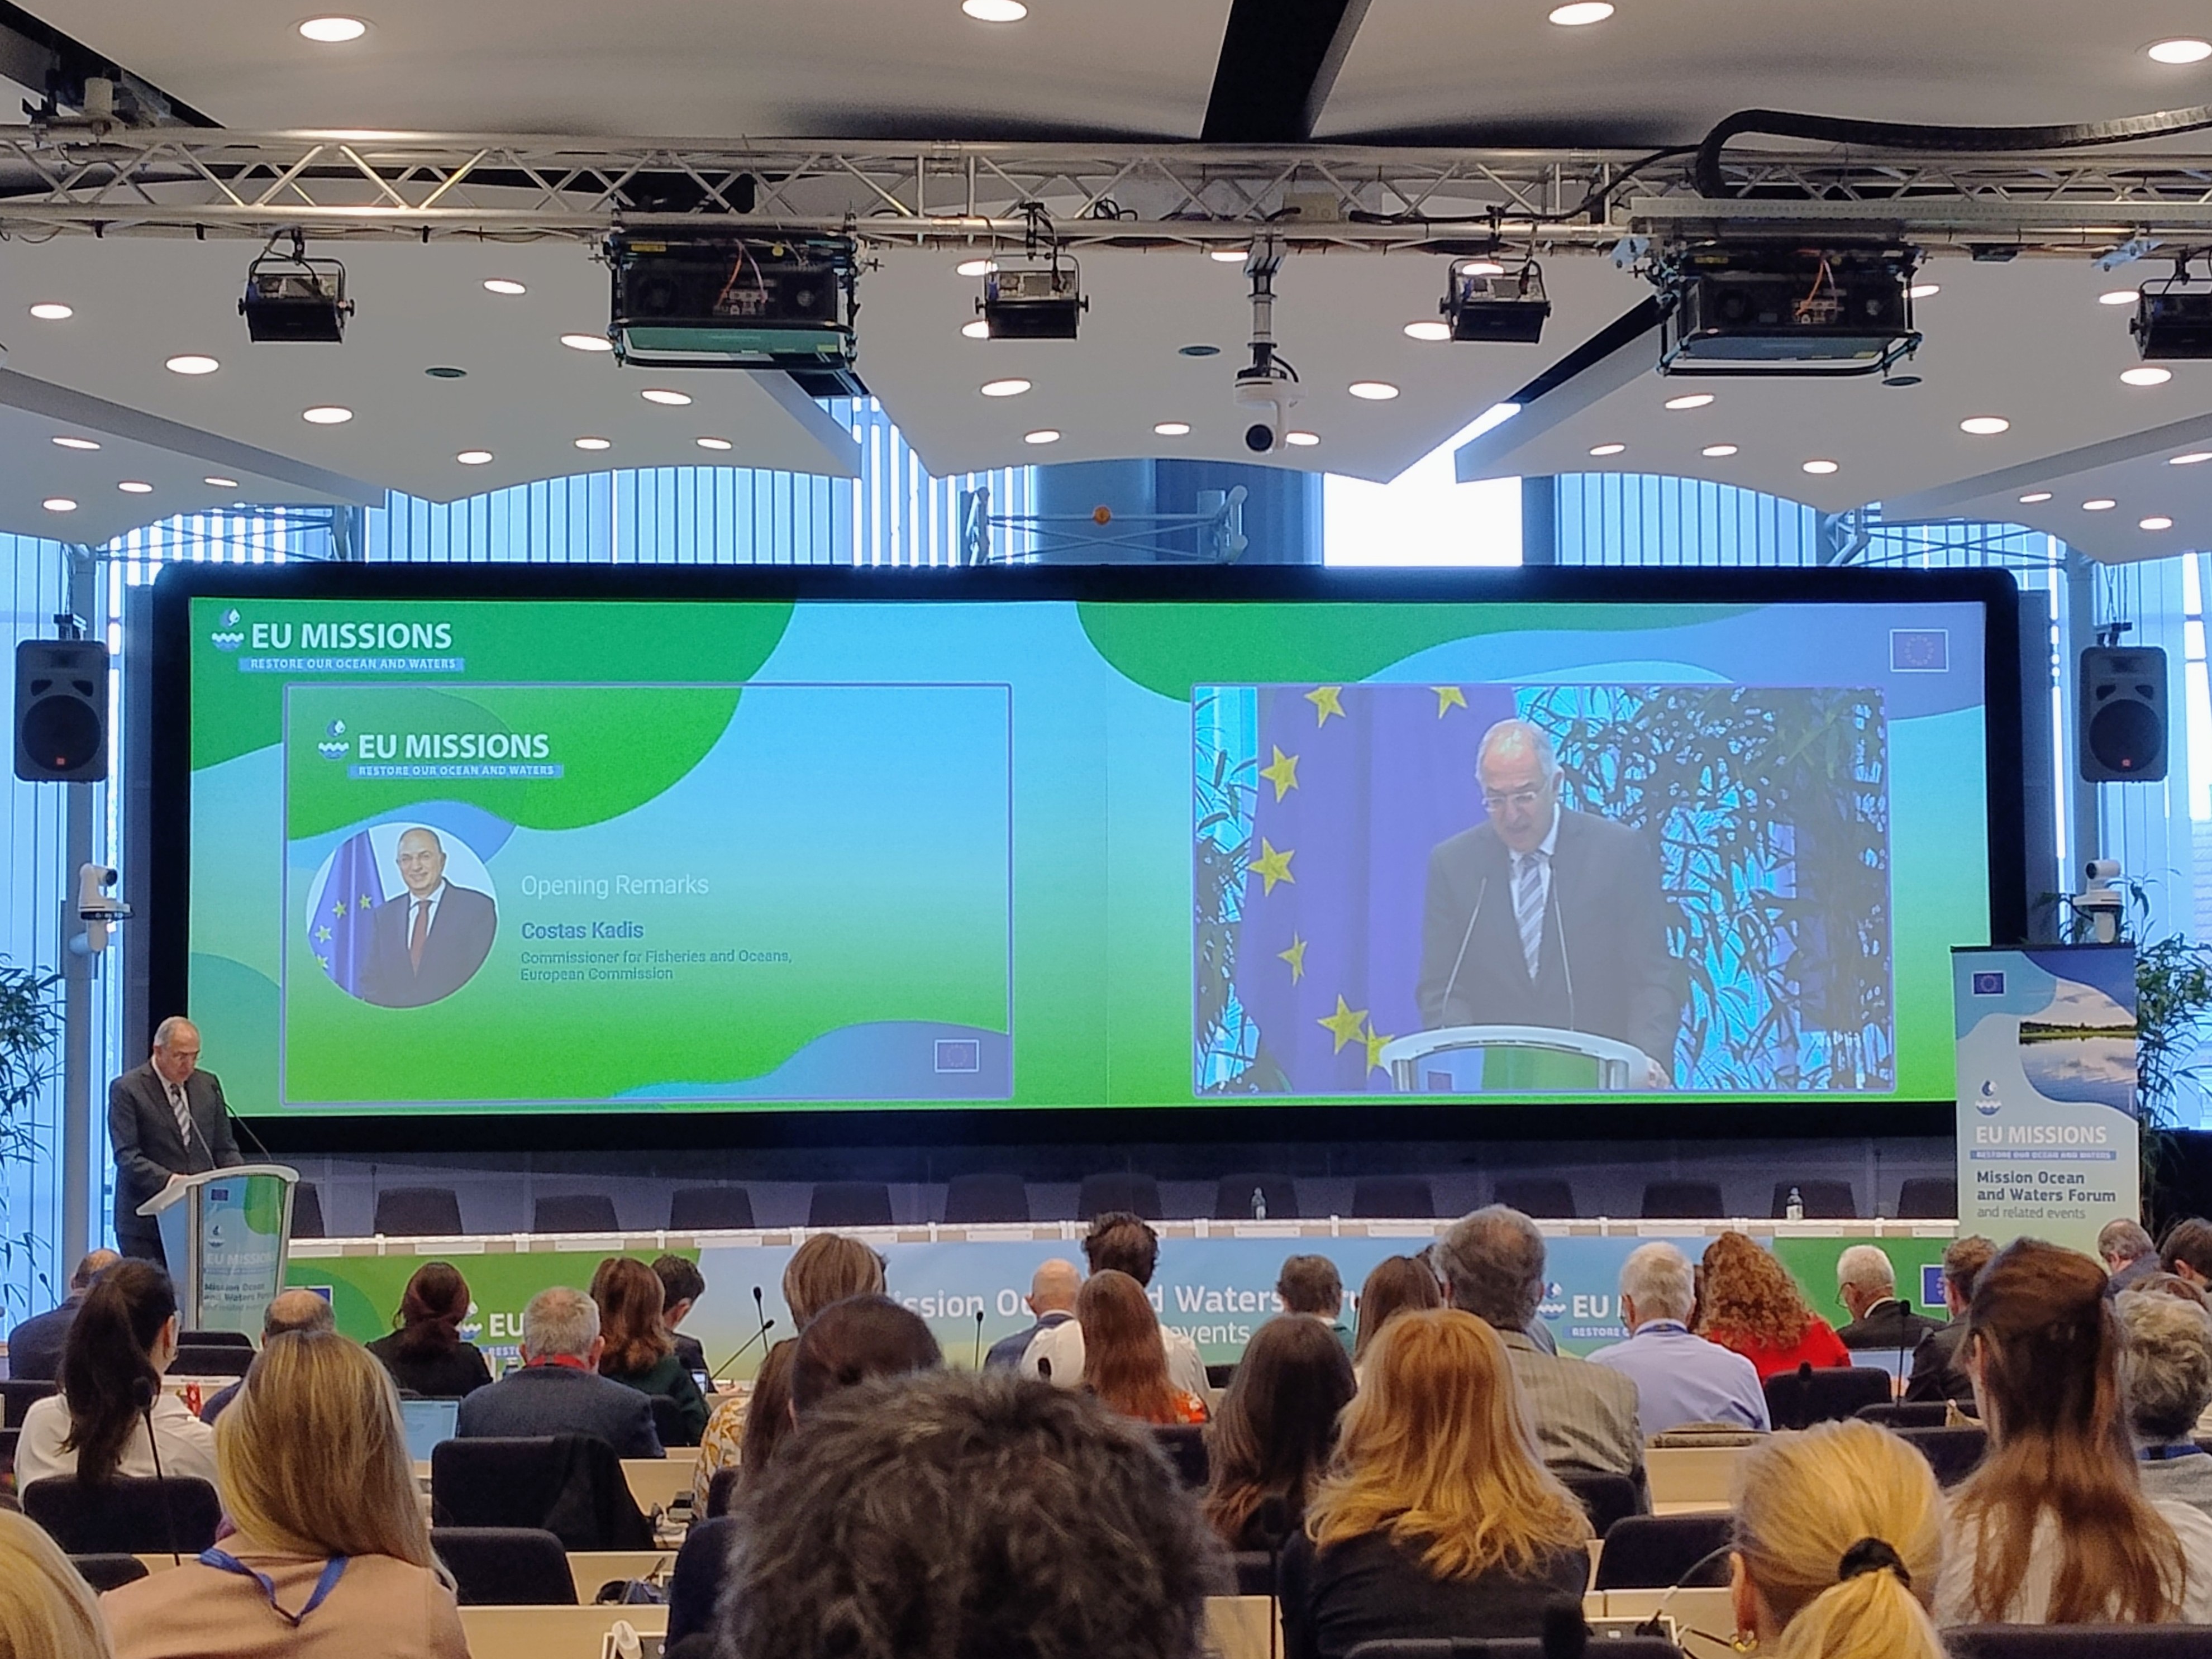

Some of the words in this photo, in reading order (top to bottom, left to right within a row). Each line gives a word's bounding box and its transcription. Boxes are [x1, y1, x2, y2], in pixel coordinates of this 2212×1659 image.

[252, 623, 292, 649] EU
[301, 623, 452, 649] MISSIONS
[251, 659, 303, 669] RESTORE
[307, 659, 332, 669] OUR
[336, 659, 376, 669] OCEAN
[379, 659, 406, 669] AND
[408, 659, 455, 669] WATERS
[359, 734, 397, 759] EU
[405, 733, 550, 759] MISSIONS
[358, 766, 409, 776] RESTORE
[412, 766, 436, 776] OUR
[439, 766, 479, 776] OCEAN
[482, 766, 506, 775] AND
[509, 765, 554, 775] WATERS
[521, 875, 609, 899] Opening
[616, 874, 709, 895] Remarks
[522, 922, 587, 940] Costas
[592, 921, 644, 939] Kadis
[521, 951, 619, 965] Commissioner
[623, 950, 642, 964] for
[646, 950, 706, 964] Fisheries
[709, 950, 735, 962] and
[738, 950, 792, 964] Oceans,
[521, 968, 585, 983] European
[588, 967, 673, 981] Commission
[1976, 1126, 2003, 1144] EU
[2008, 1126, 2108, 1144] MISSIONS
[1977, 1170, 2033, 1184] Mission
[2038, 1171, 2085, 1184] Ocean
[1977, 1188, 2005, 1200] and
[2009, 1188, 2063, 1201] Waters
[2068, 1189, 2116, 1202] Forum
[1977, 1206, 2000, 1218] and
[2003, 1207, 2043, 1218] related
[2047, 1207, 2086, 1219] events
[894, 1290, 984, 1318] ission
[1174, 1285, 1286, 1313] Waters
[1572, 1295, 1609, 1318] EU
[489, 1312, 524, 1337] EU
[1572, 1327, 1620, 1337] RESTORE
